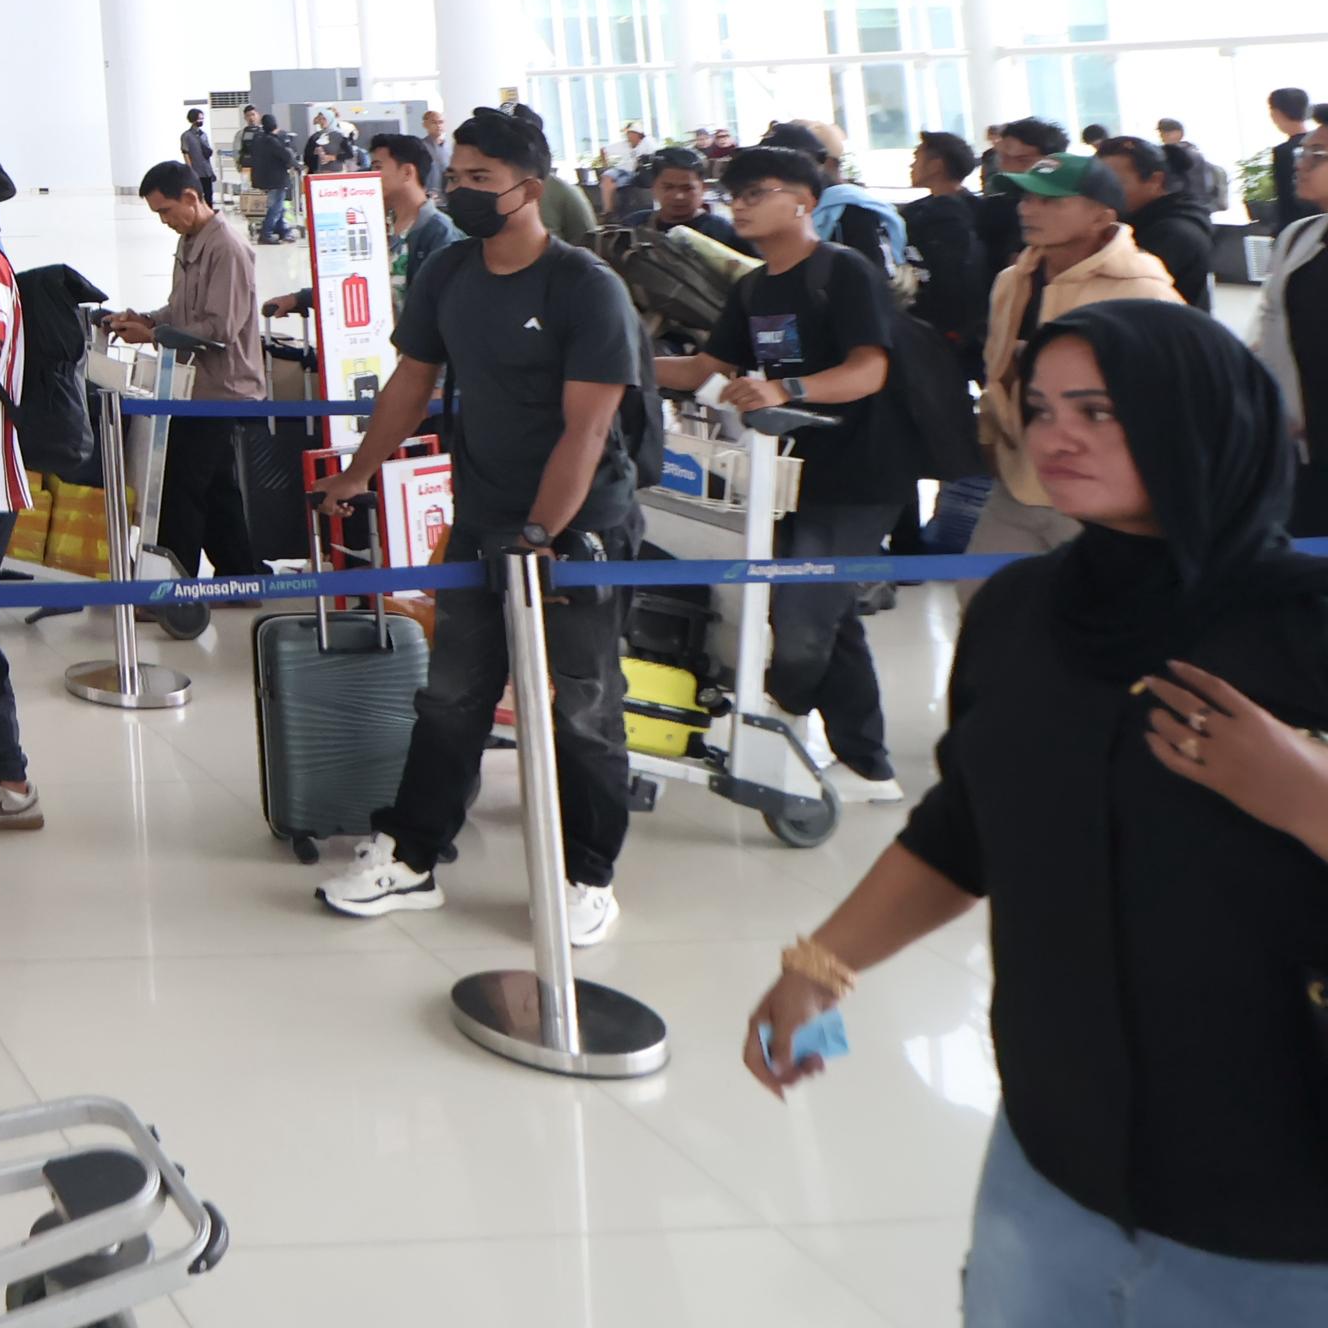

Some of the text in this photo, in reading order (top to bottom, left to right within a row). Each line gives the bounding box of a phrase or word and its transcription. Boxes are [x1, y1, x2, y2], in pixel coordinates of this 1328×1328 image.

[318, 187, 338, 198] Lion
[418, 483, 442, 496] Lion
[174, 578, 318, 599] AngkasaPura AIRPORTS
